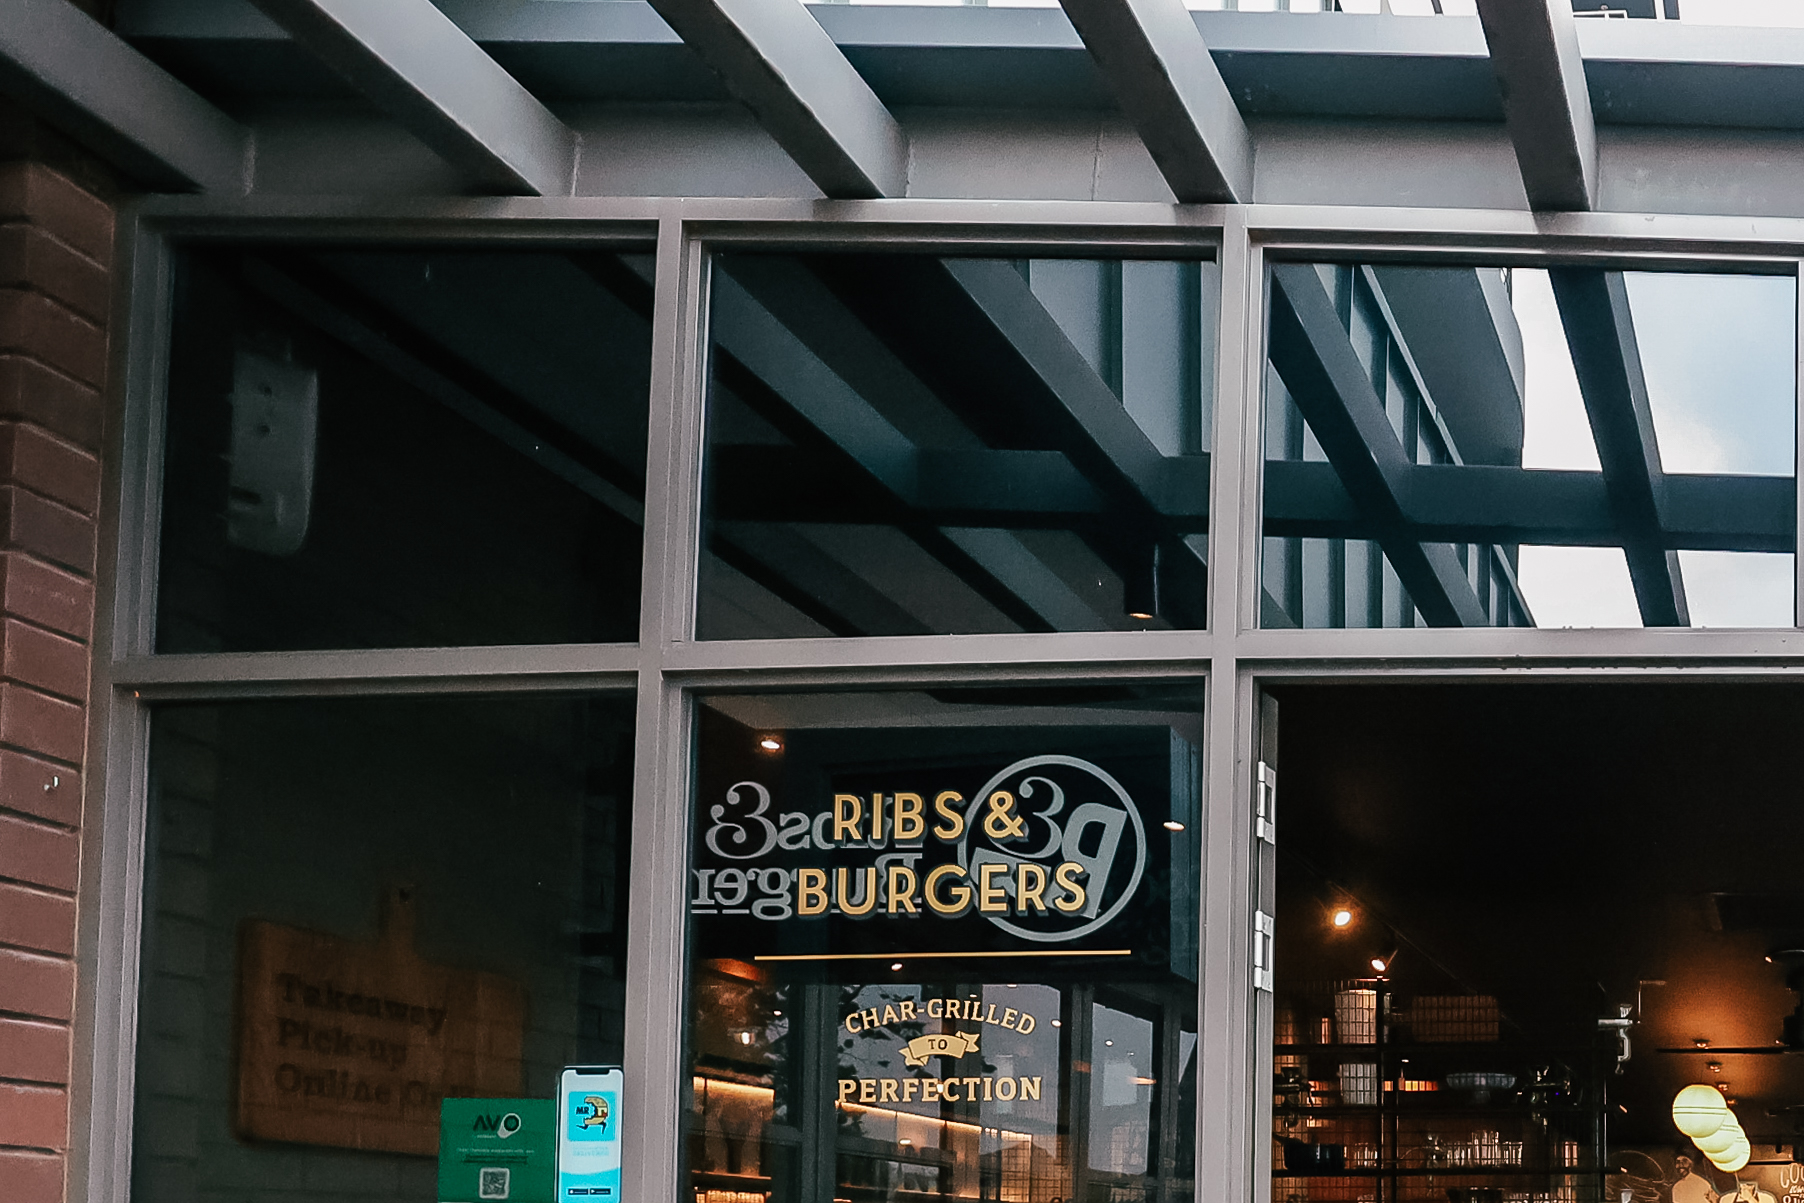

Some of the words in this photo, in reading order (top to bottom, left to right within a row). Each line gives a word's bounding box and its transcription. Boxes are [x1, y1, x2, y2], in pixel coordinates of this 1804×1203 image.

[832, 790, 966, 843] RIBS
[983, 790, 1027, 842] &
[796, 861, 1089, 918] BURGERS
[275, 972, 448, 1037] Takeaway
[845, 998, 1037, 1035] CHAR-GRILLED
[275, 1015, 408, 1071] Pick-up
[927, 1038, 949, 1051] TO
[275, 1063, 392, 1106] Online
[838, 1076, 1042, 1103] PERFECTION
[472, 1114, 520, 1132] AVO
[575, 1106, 590, 1115] MR
